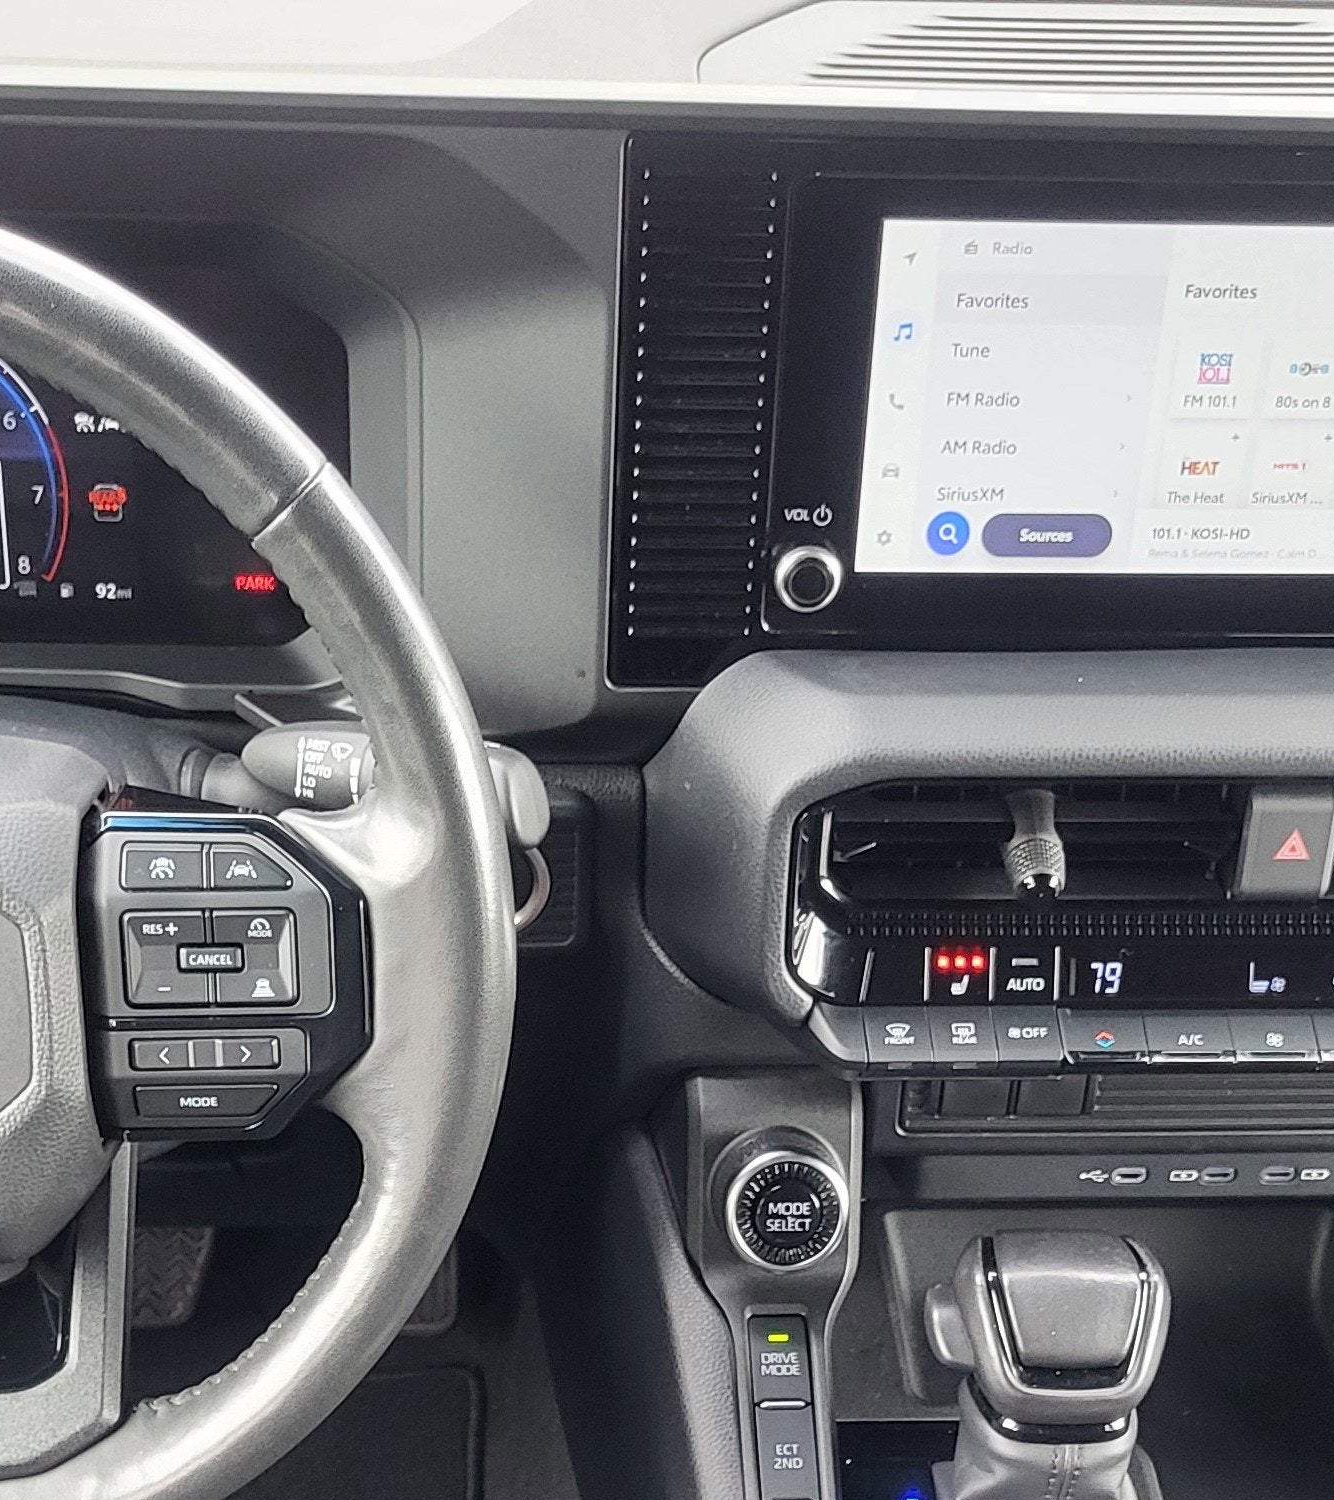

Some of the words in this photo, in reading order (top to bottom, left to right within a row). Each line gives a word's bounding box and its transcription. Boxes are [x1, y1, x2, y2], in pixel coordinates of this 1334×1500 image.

[992, 242, 1033, 256] Radio
[1184, 283, 1258, 300] Favorites
[956, 293, 1029, 310] Favorites
[952, 343, 990, 359] Tune
[1200, 353, 1234, 367] KOSI
[946, 393, 970, 408] FM
[974, 392, 1020, 408] Radio
[1183, 395, 1205, 408] FM
[1207, 395, 1237, 408] 101.1
[1275, 396, 1299, 409] 80s
[1301, 399, 1320, 409] on
[1322, 396, 1331, 409] 8
[2, 411, 17, 431] 6
[941, 441, 967, 455] AM
[971, 440, 1017, 456] Radio
[1180, 461, 1220, 476] HEAT
[31, 485, 45, 505] 7
[936, 487, 1004, 502] SiriusXM
[1166, 492, 1190, 504] The
[1193, 492, 1224, 504] Heat
[1251, 492, 1307, 505] SiriusXM
[784, 508, 810, 521] VOL
[1019, 528, 1074, 544] Sources
[1152, 528, 1181, 540] 101.1
[1191, 528, 1250, 541] KOSI-HD
[17, 555, 31, 575] 8
[235, 575, 275, 591] PARK
[95, 582, 116, 600] 92
[304, 763, 332, 779] AUTO
[302, 776, 317, 788] LO
[142, 923, 163, 936] RES
[247, 929, 273, 938] MODE
[188, 953, 233, 966] CANCEL
[1006, 977, 1045, 992] AUTO
[1090, 962, 1123, 994] 79
[1022, 1027, 1048, 1039] OFF
[1178, 1034, 1204, 1046] A/C
[884, 1036, 915, 1045] FRONT
[951, 1036, 977, 1045] REAR
[179, 1096, 219, 1108] MODE
[768, 1202, 811, 1216] MODE
[766, 1218, 813, 1232] SELECT
[760, 1352, 799, 1364] DRIVE
[761, 1364, 801, 1377] MODE
[775, 1443, 800, 1456] ECT
[773, 1457, 804, 1470] 2ND
